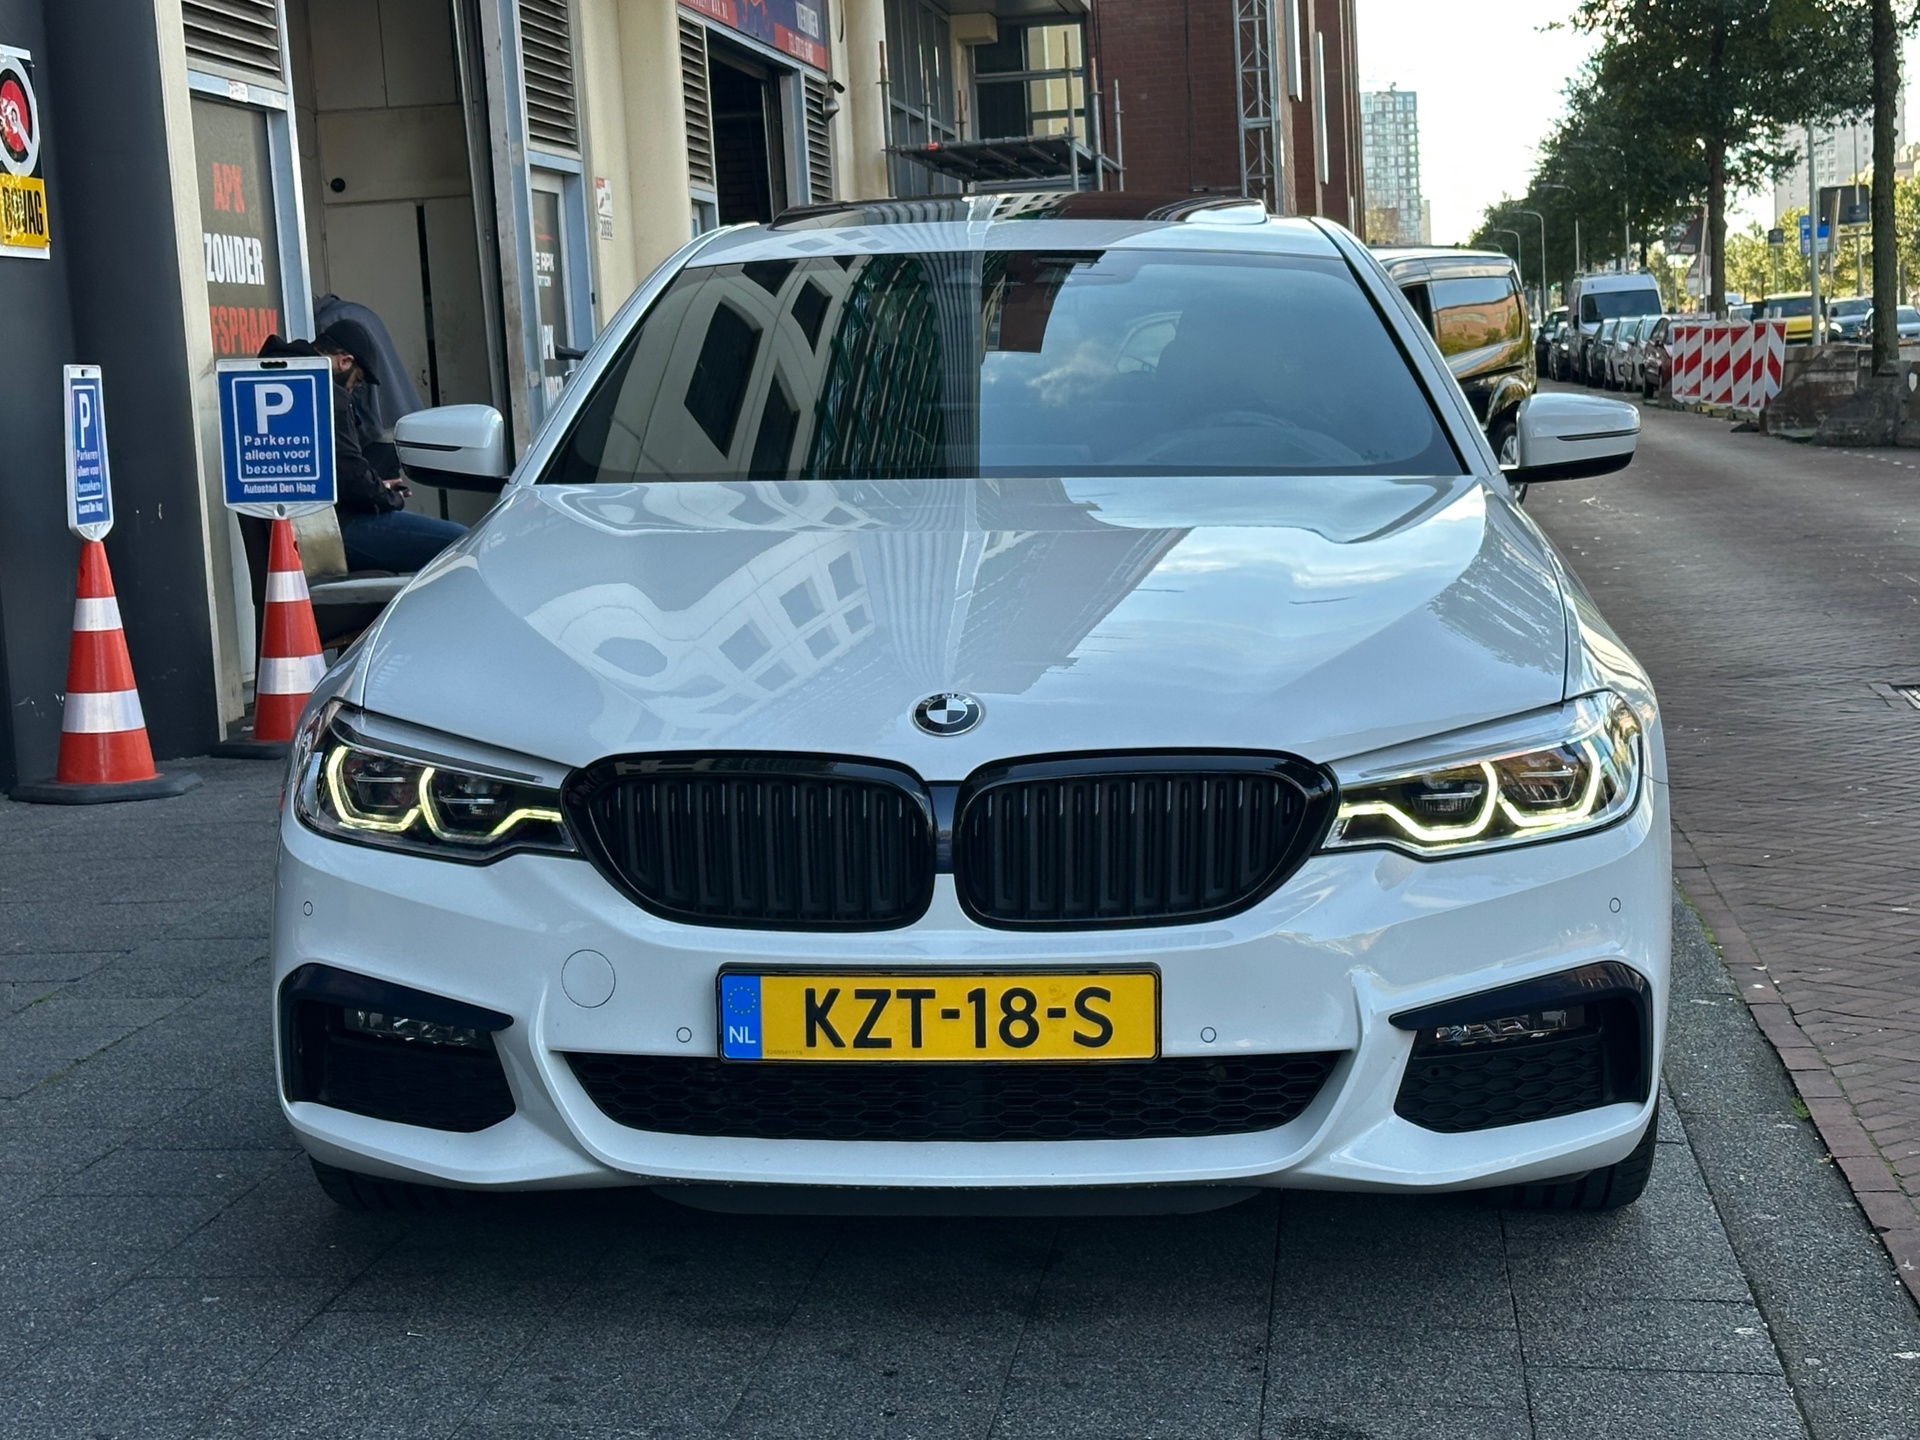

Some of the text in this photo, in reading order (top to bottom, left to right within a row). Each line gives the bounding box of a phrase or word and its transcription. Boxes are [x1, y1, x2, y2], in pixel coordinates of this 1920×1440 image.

[2, 186, 44, 236] BOVAG
[212, 161, 245, 213] APK
[204, 233, 265, 285] ZONDER
[210, 306, 278, 355] FSPRAAK
[79, 393, 91, 448] P
[255, 384, 294, 434] P
[244, 435, 310, 447] Parkeren
[245, 450, 311, 461] alleen voor
[244, 482, 317, 495] Autostad Den Haag
[246, 464, 311, 475] bezoekers
[729, 1026, 756, 1044] NL
[804, 987, 1113, 1049] KZT-18-S
